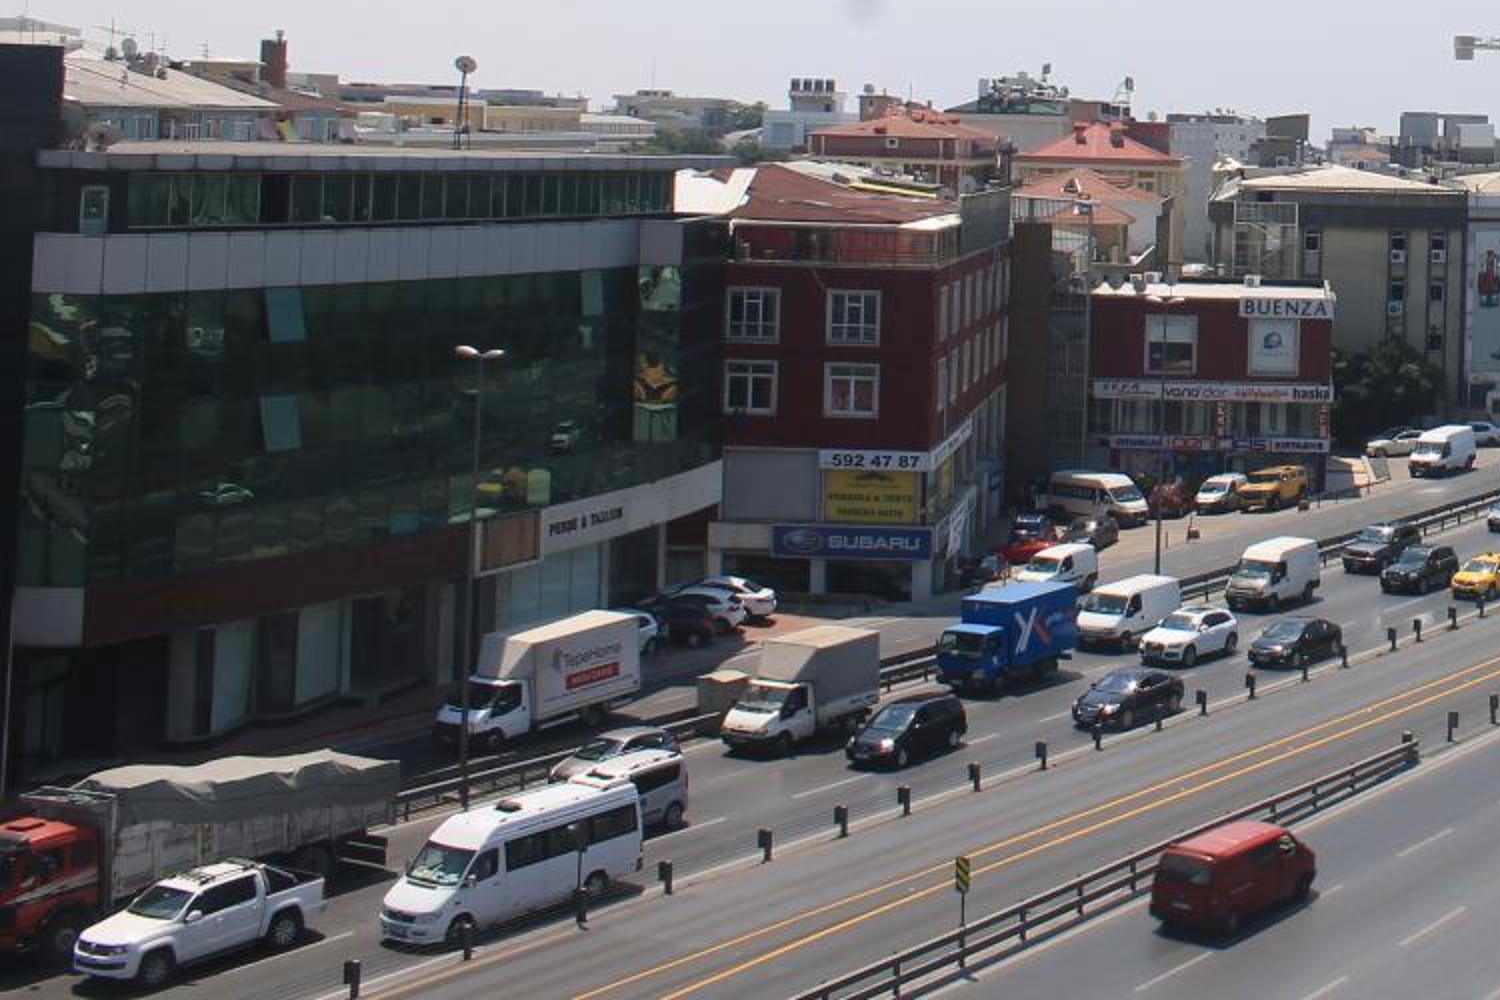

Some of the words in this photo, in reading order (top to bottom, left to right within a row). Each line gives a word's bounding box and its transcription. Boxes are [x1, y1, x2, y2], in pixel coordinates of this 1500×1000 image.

[1244, 301, 1327, 315] BUENZA
[831, 453, 865, 467] 592
[870, 455, 892, 468] 47
[898, 455, 920, 468] 87
[828, 535, 921, 550] SUBARU
